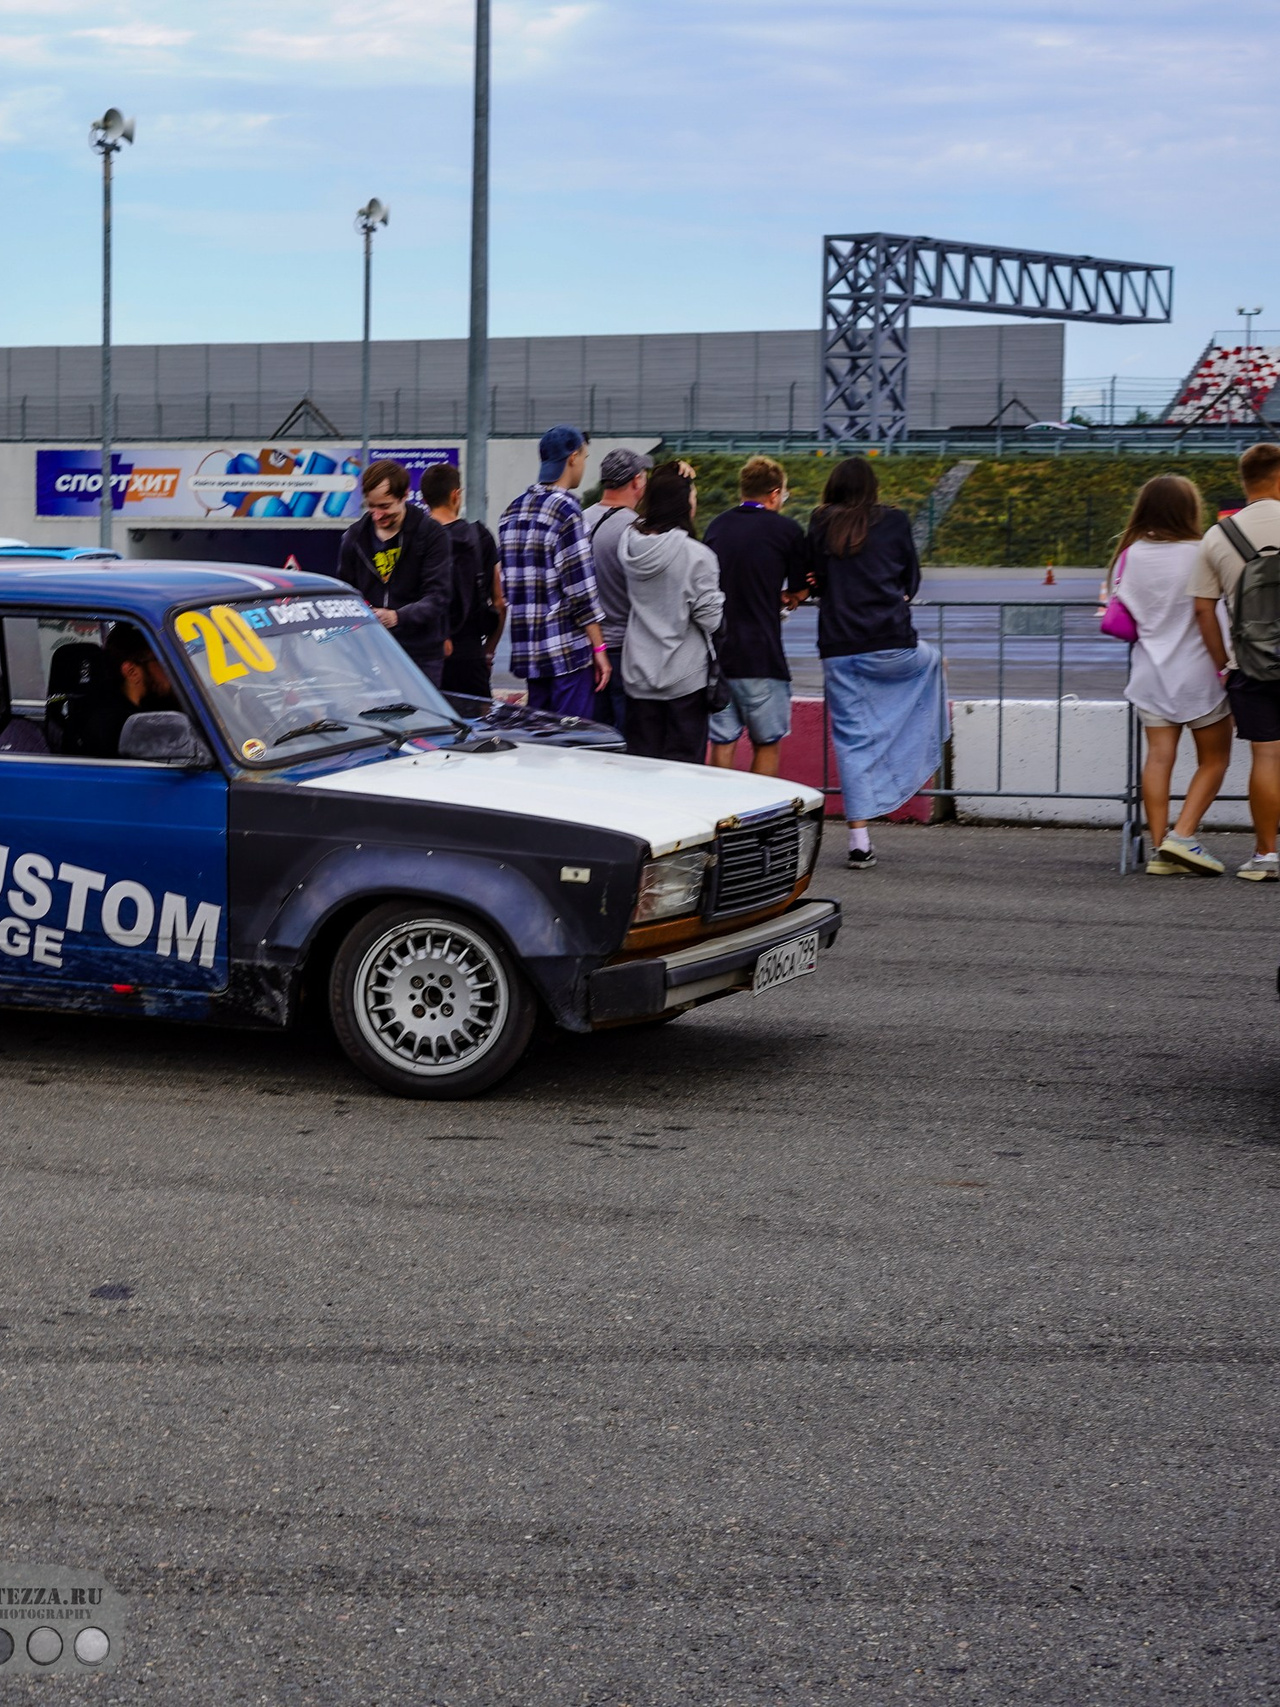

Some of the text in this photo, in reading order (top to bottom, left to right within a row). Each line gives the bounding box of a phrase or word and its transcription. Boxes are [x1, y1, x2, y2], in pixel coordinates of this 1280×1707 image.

[268, 601, 320, 625] DRIFT
[315, 599, 370, 619] SERIES
[175, 604, 277, 686] 20
